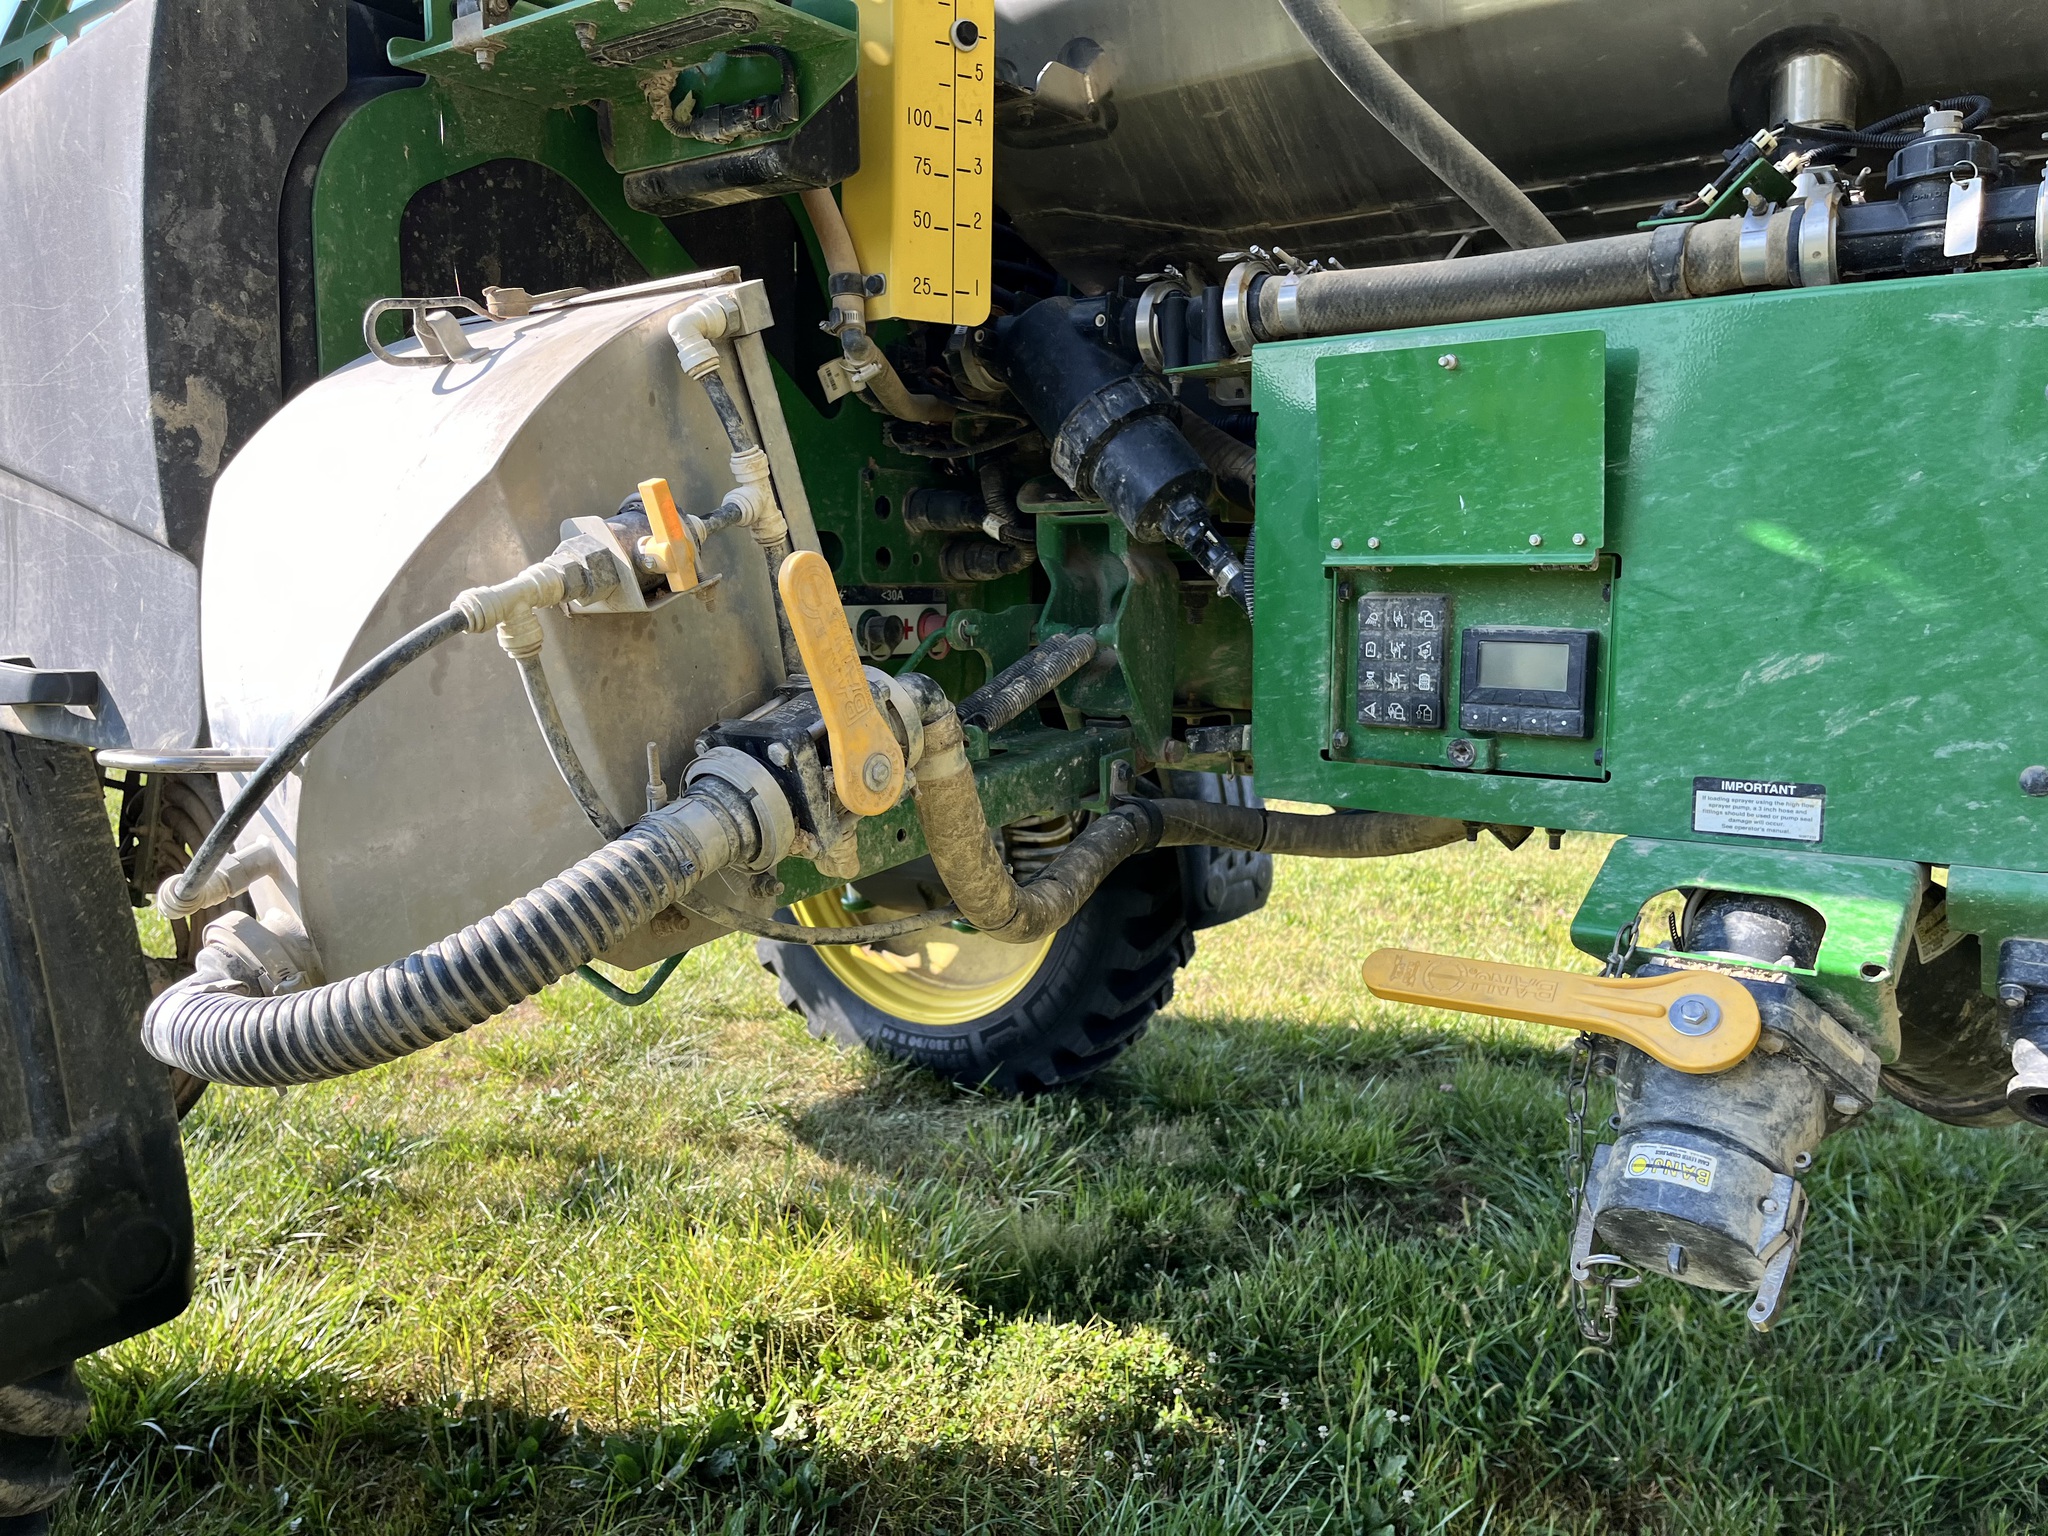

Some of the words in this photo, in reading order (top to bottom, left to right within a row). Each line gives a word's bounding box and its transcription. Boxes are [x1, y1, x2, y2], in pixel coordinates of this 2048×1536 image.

[975, 64, 983, 81] 5
[907, 107, 932, 128] 100
[975, 109, 983, 126] 4
[914, 156, 931, 175] 75
[974, 158, 982, 175] 3
[914, 211, 931, 229] 50
[974, 213, 982, 229] 2
[914, 277, 930, 295] 25
[1721, 781, 1796, 795] IMPORTANT
[1628, 1153, 1711, 1186] BANJO
